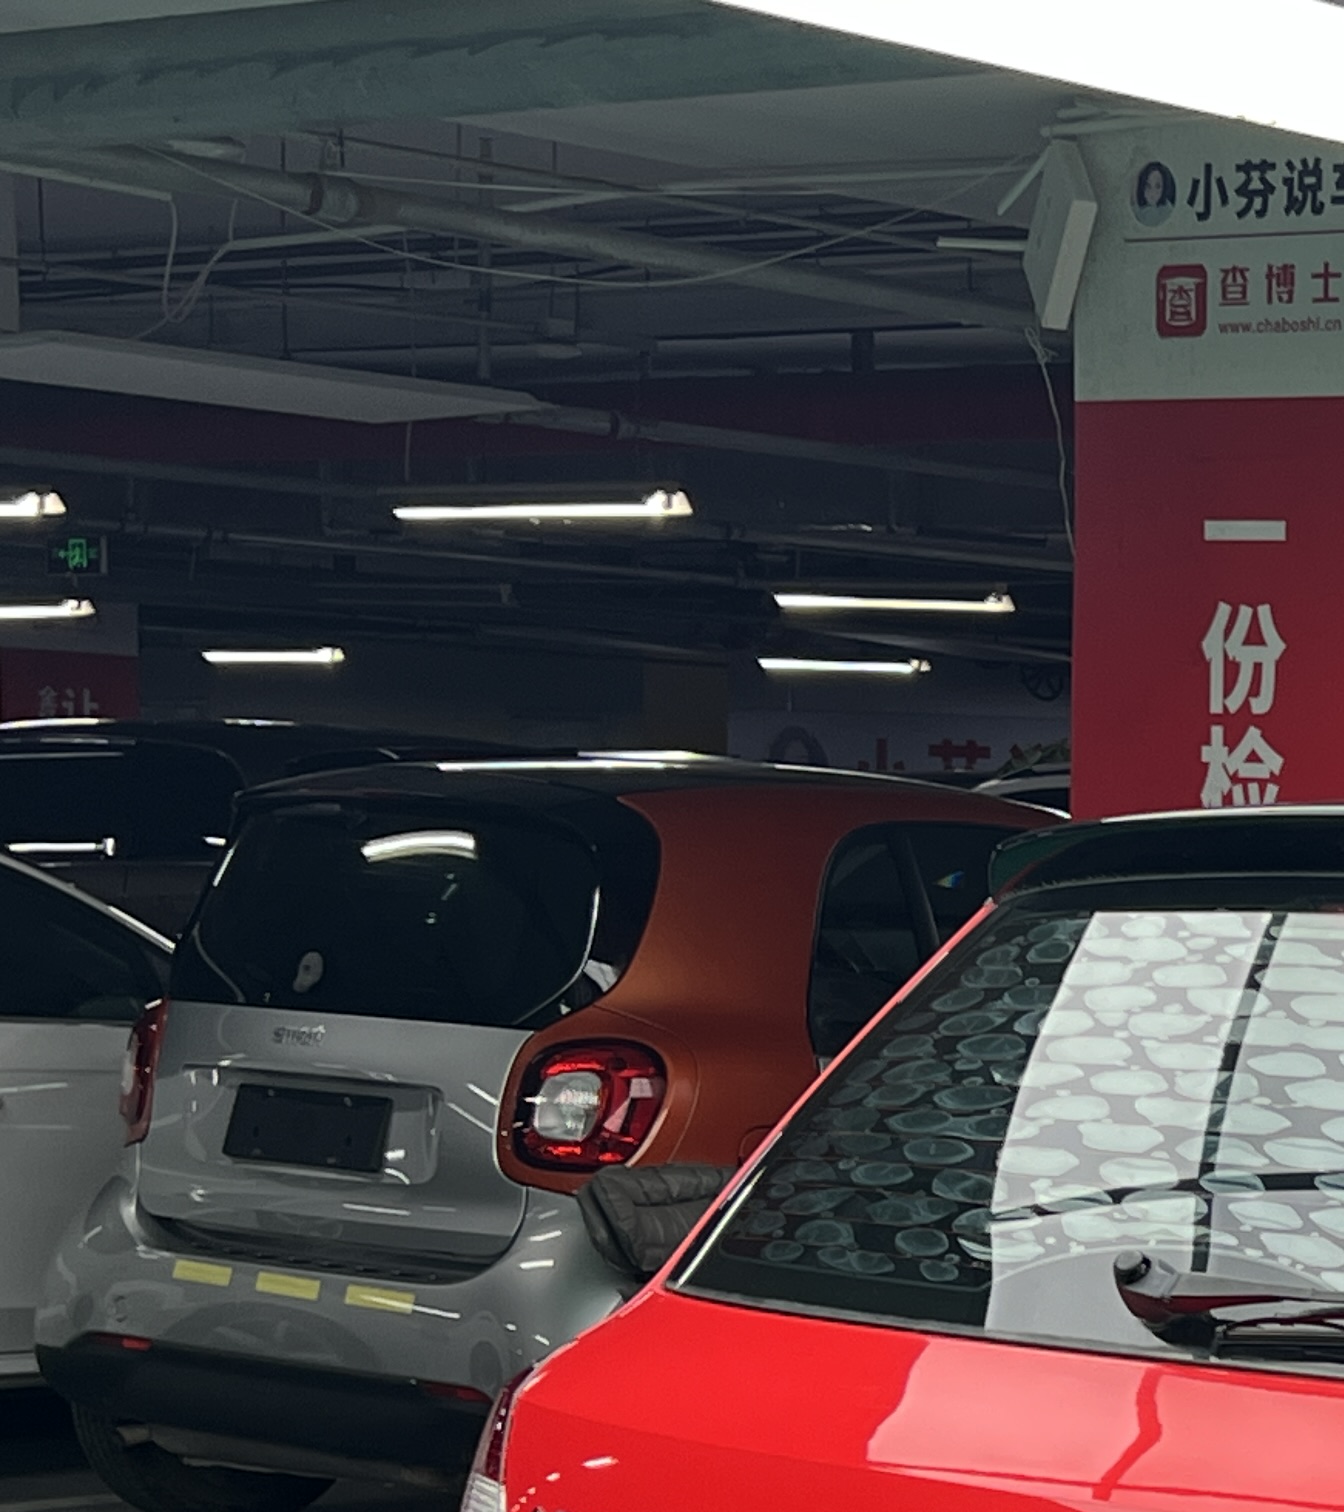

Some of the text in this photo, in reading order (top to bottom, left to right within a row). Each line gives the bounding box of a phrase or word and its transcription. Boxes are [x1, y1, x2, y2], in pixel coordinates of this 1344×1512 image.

[1218, 260, 1343, 307] 查博士
[1217, 316, 1343, 335] www.chaboshi.cn
